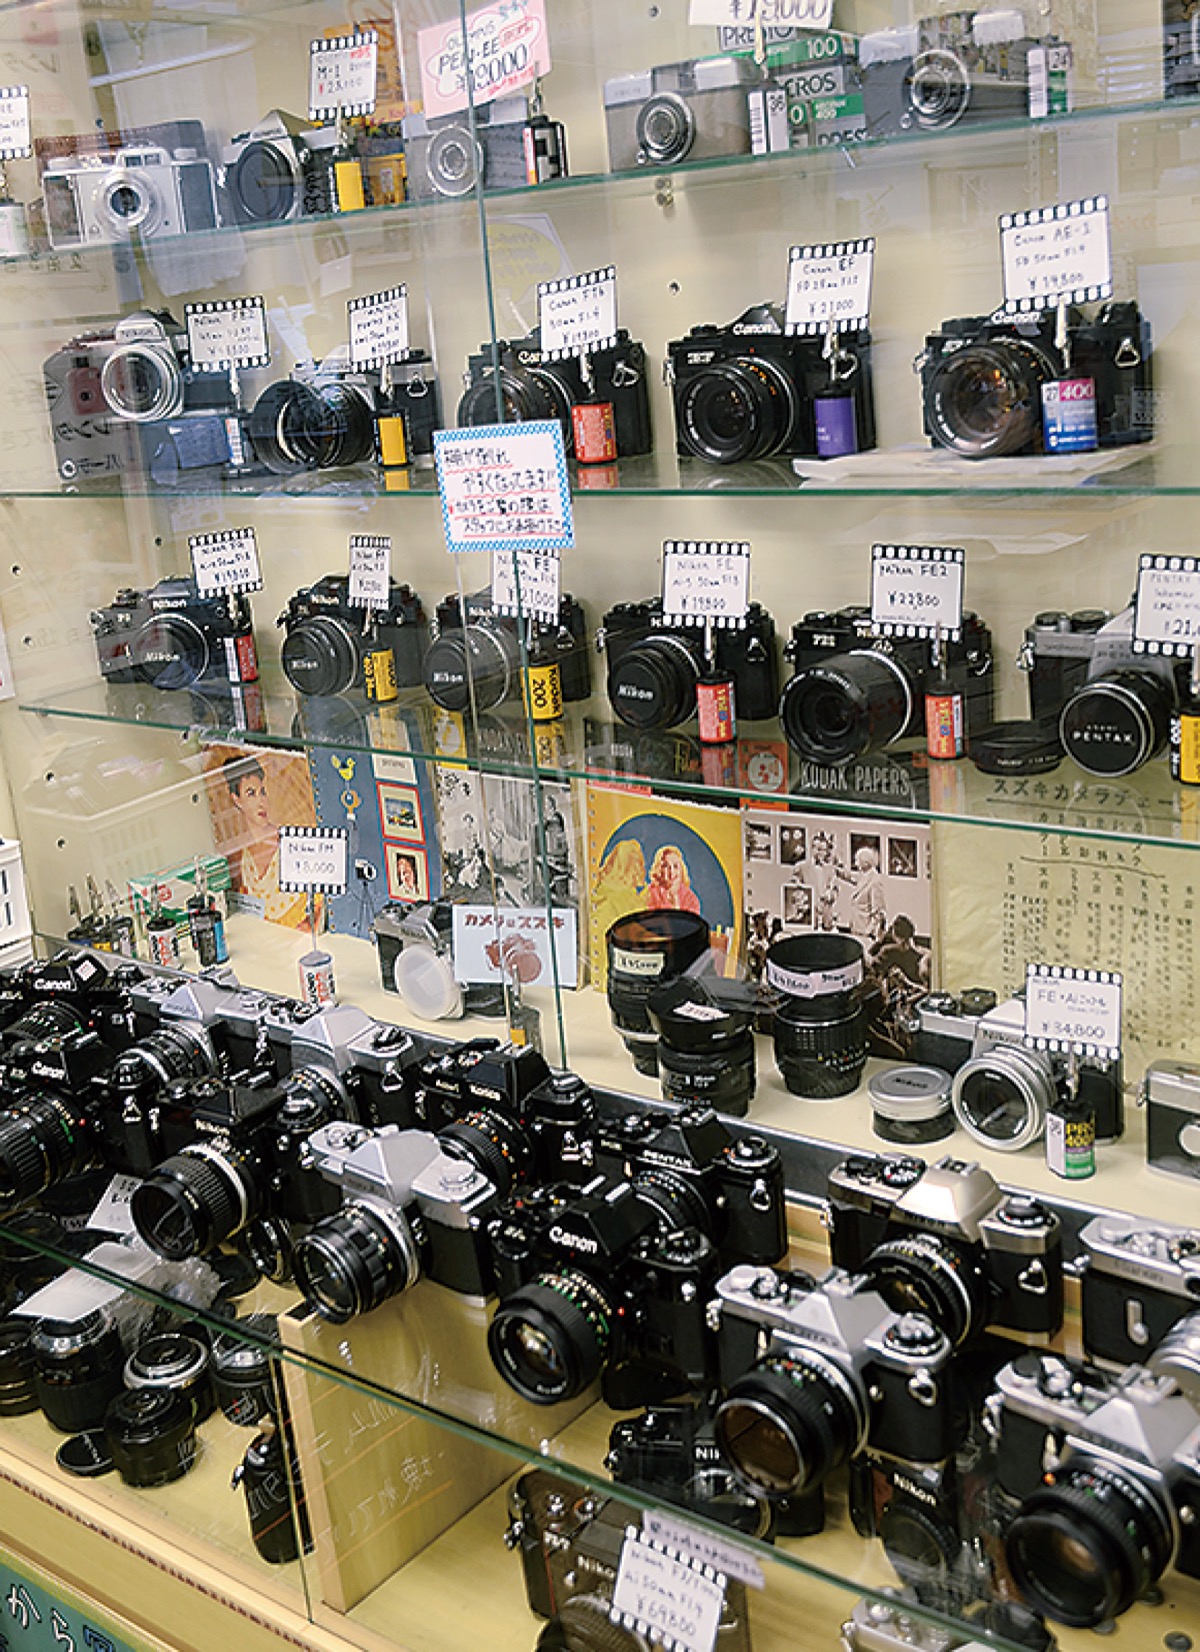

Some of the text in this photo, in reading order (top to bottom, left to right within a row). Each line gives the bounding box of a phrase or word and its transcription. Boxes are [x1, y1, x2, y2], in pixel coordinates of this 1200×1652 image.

[807, 36, 838, 59] 100
[617, 684, 655, 702] Nikon
[1072, 731, 1134, 745] PENTAX
[854, 765, 911, 797] PAPERS
[35, 978, 72, 991] Canon
[549, 1225, 599, 1255] Canon
[893, 1472, 937, 1507] Nikon
[577, 1553, 615, 1579] Niko
